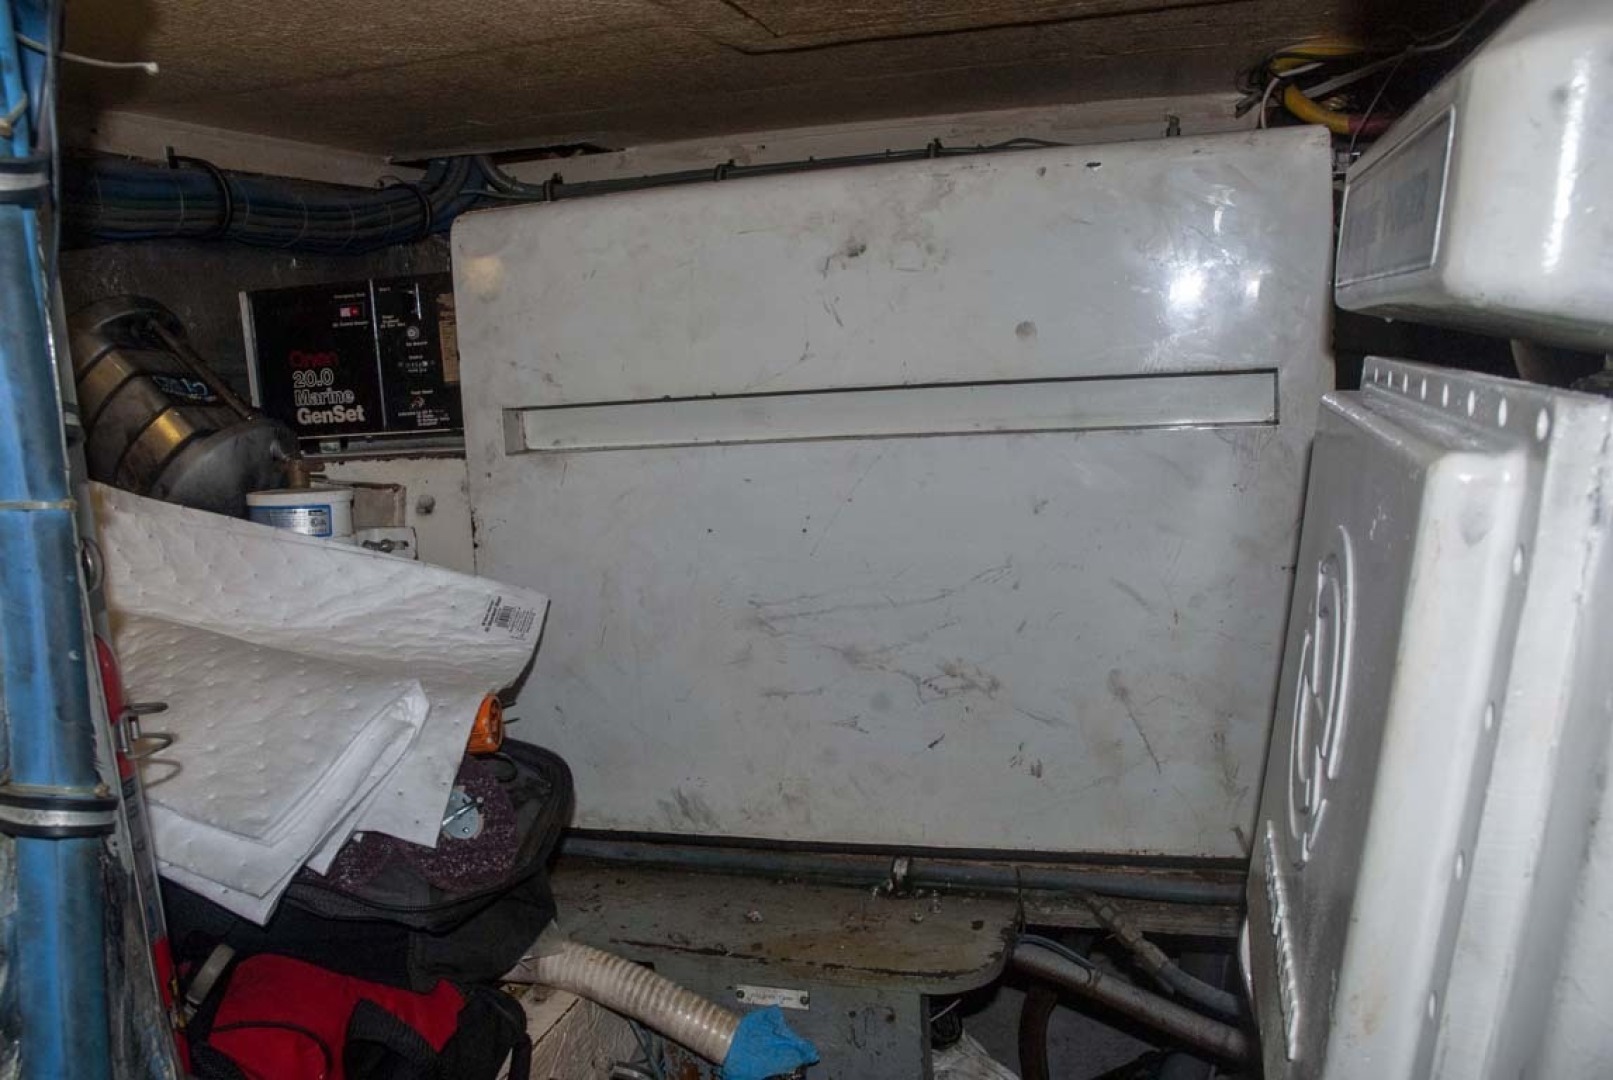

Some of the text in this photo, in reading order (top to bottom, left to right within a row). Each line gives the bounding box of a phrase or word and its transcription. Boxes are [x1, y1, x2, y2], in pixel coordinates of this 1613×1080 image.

[292, 367, 334, 388] 20.0
[293, 387, 355, 407] Marine
[296, 404, 366, 425] GenSet
